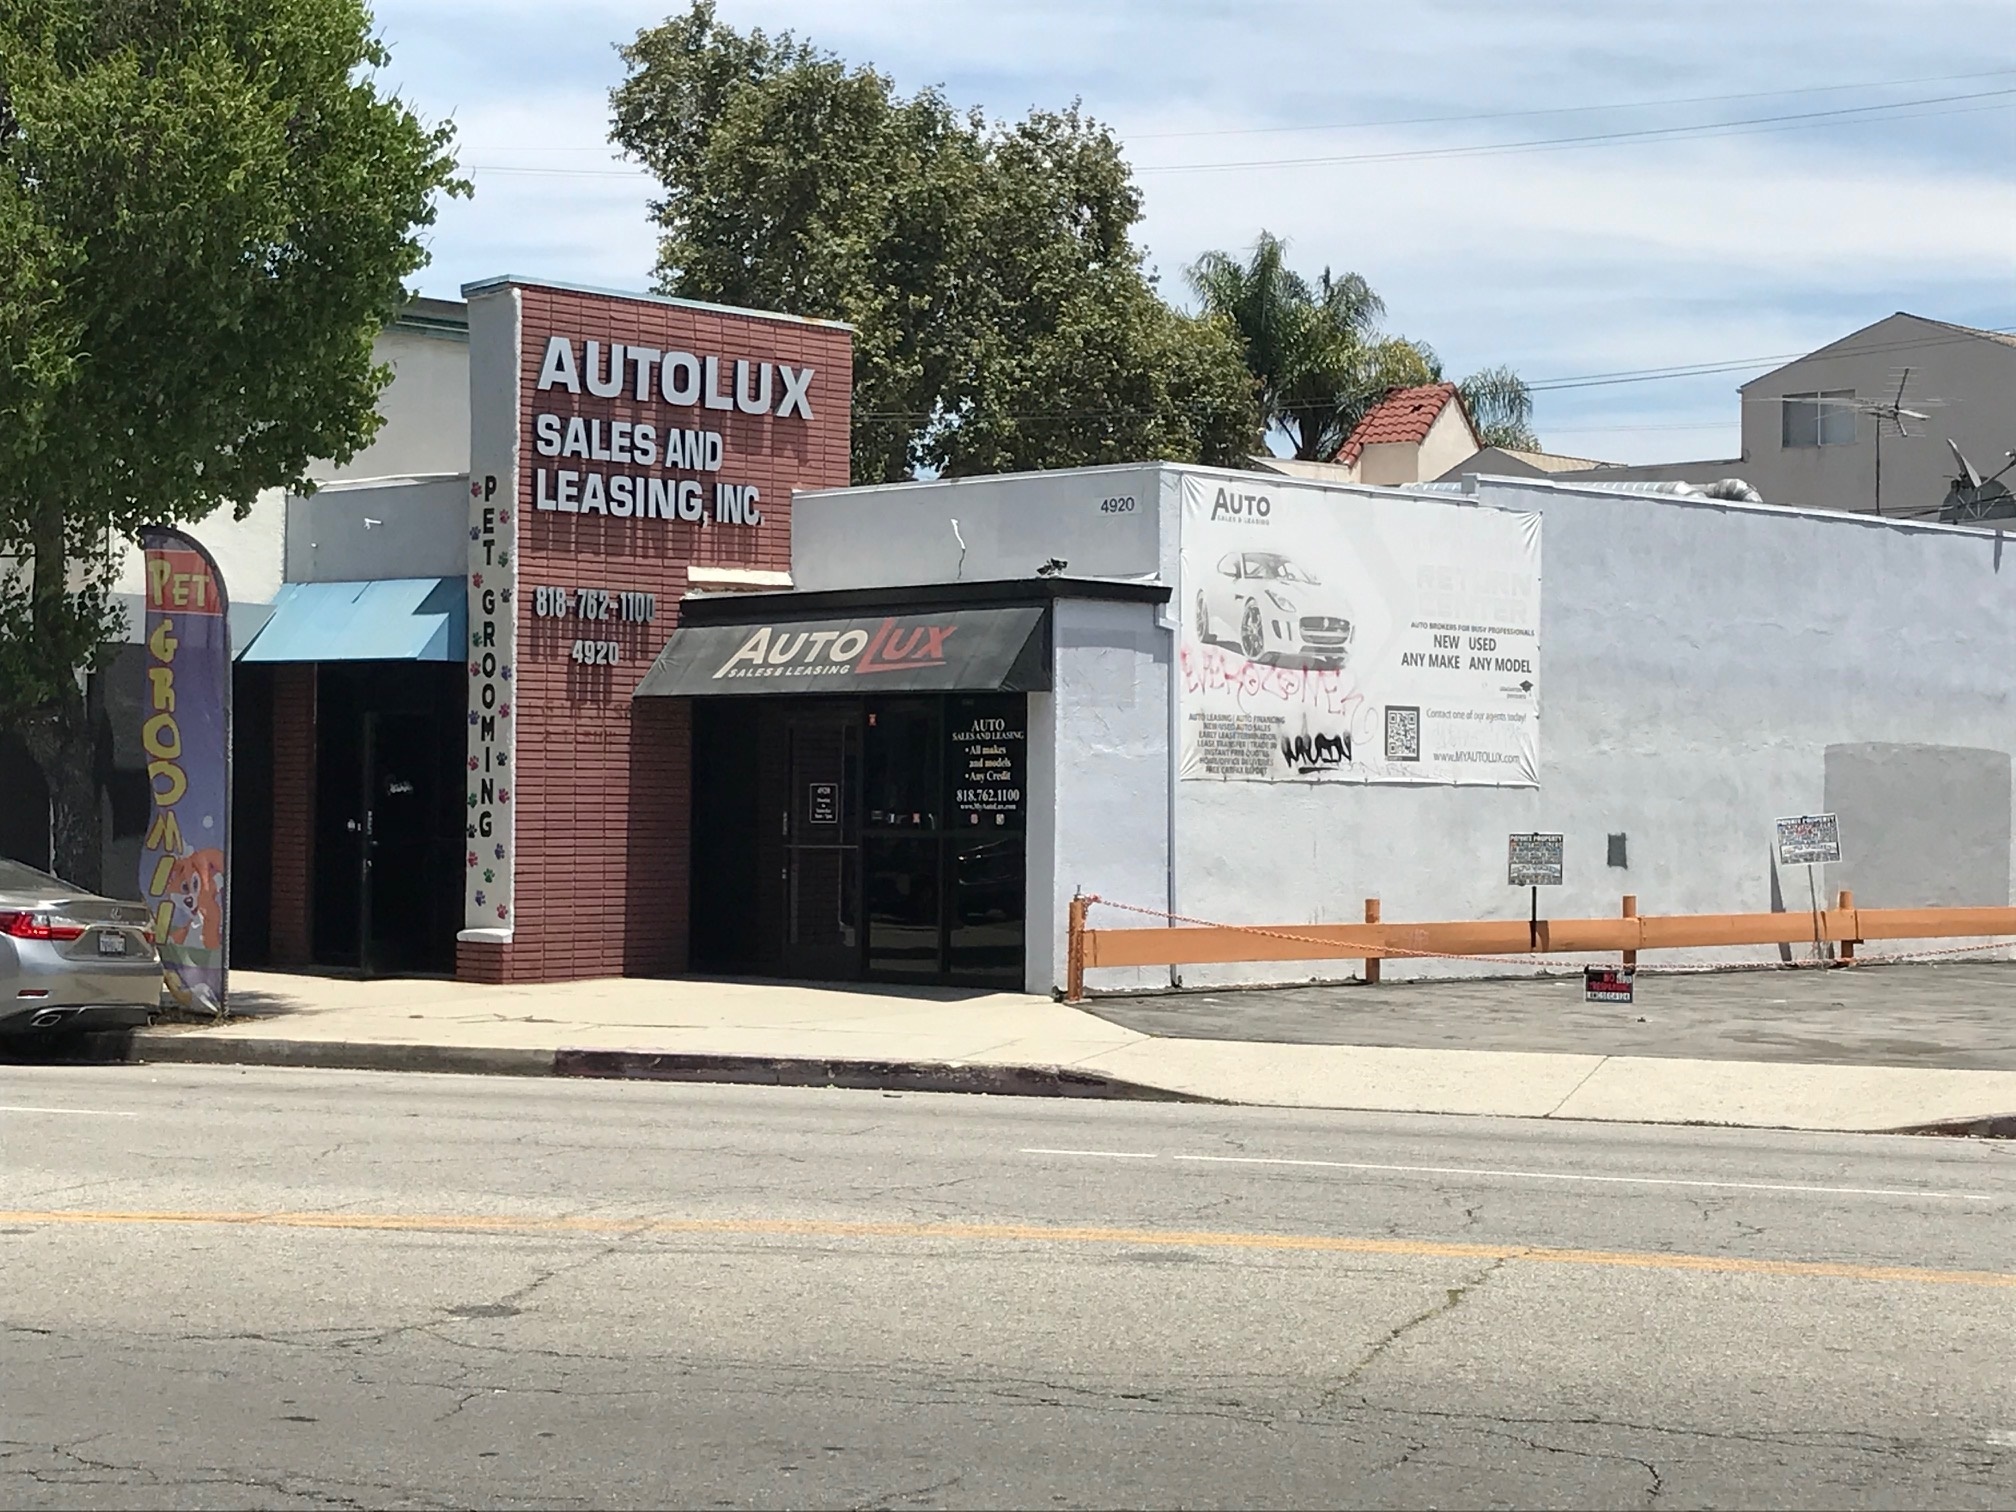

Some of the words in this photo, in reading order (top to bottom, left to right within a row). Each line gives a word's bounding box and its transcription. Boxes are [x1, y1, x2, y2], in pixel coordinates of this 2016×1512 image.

[537, 336, 816, 421] AUTOLUX
[536, 413, 657, 466] SALES
[665, 428, 723, 472] AND
[536, 468, 709, 529] LEASING,
[1100, 496, 1135, 513] 4920
[1210, 487, 1271, 521] AUTO
[482, 475, 497, 566] PET
[148, 558, 210, 607] PET
[536, 585, 656, 623] 818-762-1100
[1433, 634, 1460, 649] NEW
[1468, 637, 1496, 651] USED
[572, 639, 619, 666] 4920
[785, 664, 851, 677] LEASING
[1401, 652, 1425, 667] ANY
[1428, 653, 1460, 669] MAKE
[1468, 656, 1492, 671] ANY
[1494, 658, 1532, 673] MODEL
[477, 588, 497, 838] GROOMING
[1426, 707, 1451, 719] Contact
[1452, 711, 1465, 719] one
[971, 718, 1005, 732] AUTO
[952, 732, 976, 741] SALES
[976, 732, 991, 740] AND
[992, 731, 1024, 740] LEASING
[969, 745, 981, 755] All
[982, 744, 1006, 755] makes
[969, 758, 983, 768] and
[984, 757, 1011, 768] models
[969, 772, 985, 783] Any
[986, 770, 1011, 781] Credit
[956, 789, 1020, 802] 818.762.1100
